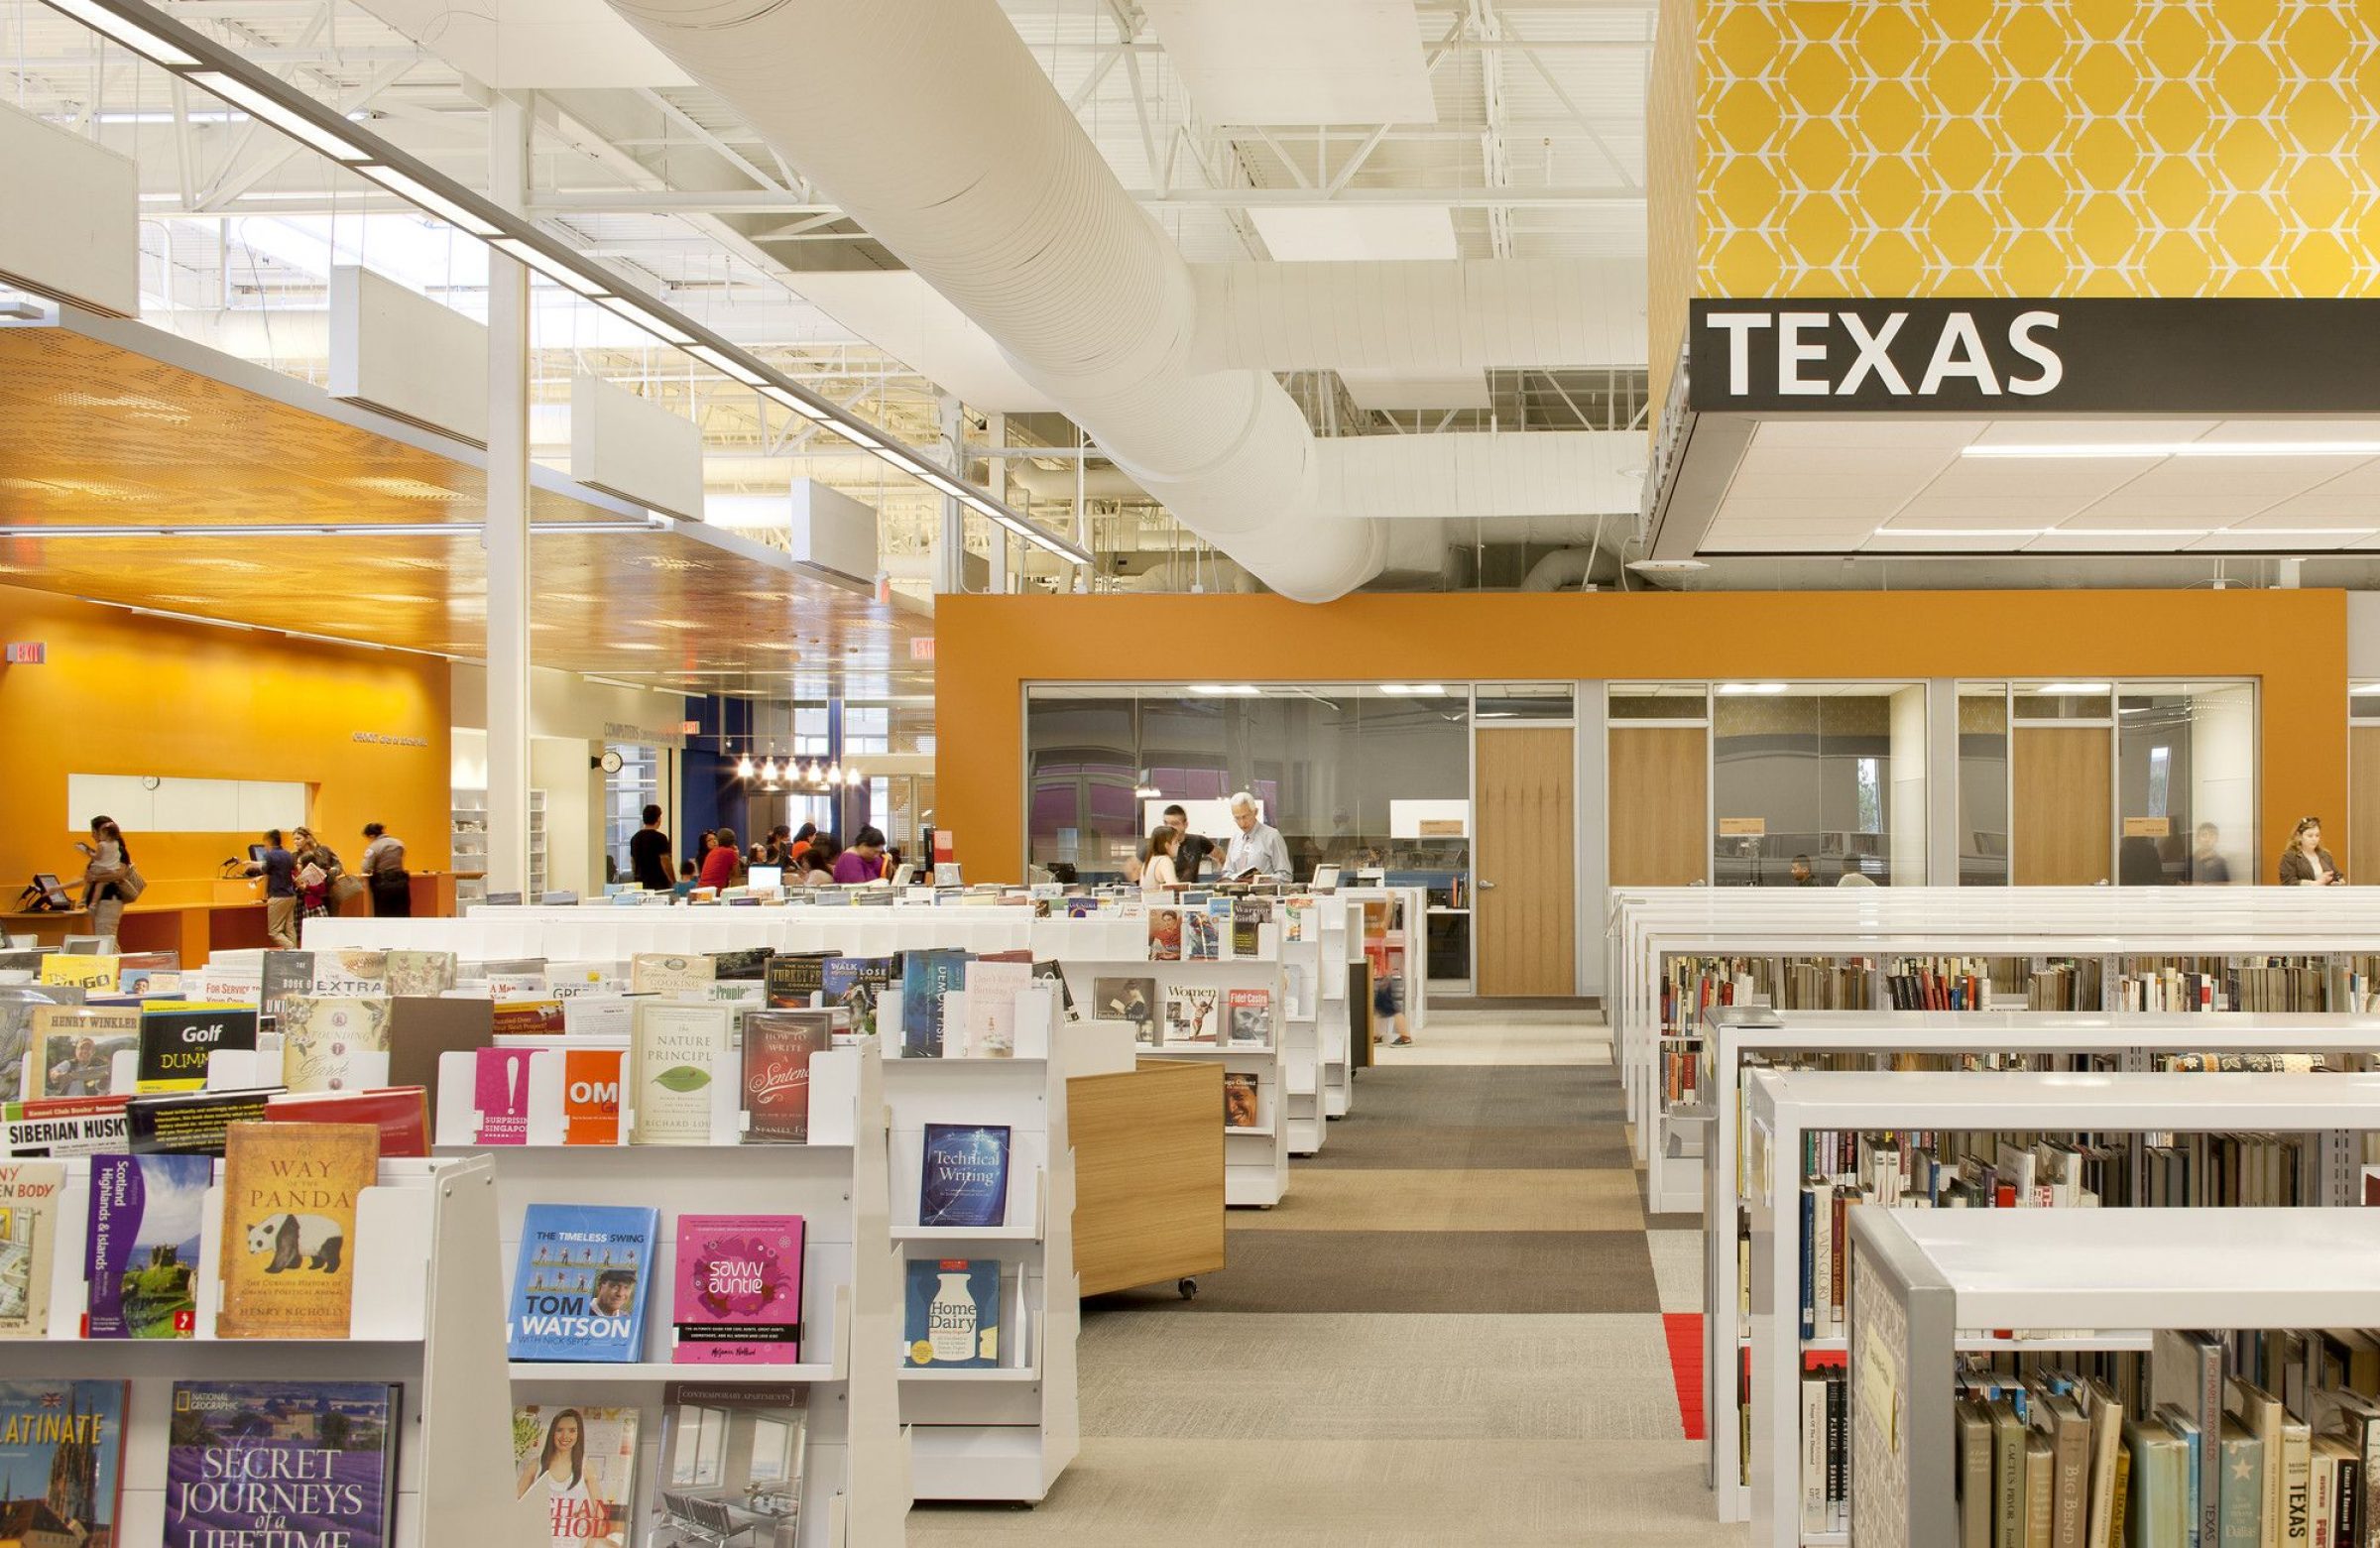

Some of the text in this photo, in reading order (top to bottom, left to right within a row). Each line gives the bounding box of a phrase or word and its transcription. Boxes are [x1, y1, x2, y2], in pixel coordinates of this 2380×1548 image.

[1707, 310, 2064, 396] TEXAS
[17, 644, 42, 661] EXIT
[316, 981, 382, 992] EXTRA
[1168, 986, 1217, 997] Women
[1230, 993, 1267, 1004] Fidel Castro
[52, 1015, 137, 1029] HENRY WINKLER
[181, 1024, 224, 1043] Golf
[657, 1035, 711, 1046] NATURE
[768, 1043, 802, 1052] WRITE
[9, 1121, 78, 1144] SIBERIAN
[933, 1149, 1000, 1166] Technical
[270, 1159, 337, 1178] WAY
[939, 1167, 994, 1187] Writing
[17, 1184, 55, 1198] BODY
[114, 1160, 129, 1207] Scotland
[98, 1167, 114, 1221] Highlands
[250, 1190, 351, 1209] PANDA
[97, 1223, 110, 1232] &
[536, 1232, 645, 1244] THE TIMELESS SWING
[1819, 1229, 1830, 1258] VAIN
[95, 1235, 109, 1270] Islands
[708, 1277, 763, 1293] auntie
[1819, 1261, 1829, 1301] GLORY
[239, 1307, 280, 1317] HENRY
[526, 1295, 584, 1316] TOM
[930, 1301, 977, 1316] Home
[522, 1315, 632, 1339] WATSON
[929, 1315, 976, 1334] Dairy
[190, 1391, 229, 1402] NATIONAL
[682, 1390, 790, 1401] CONTEMPORARY APARTMENTS
[190, 1400, 239, 1411] GEOGRAPHIC
[0, 1412, 104, 1445] ATINATE
[2205, 1357, 2216, 1542] RICHARD REYNOLDS TEXAS
[201, 1448, 342, 1481] SECRET
[2006, 1443, 2017, 1520] CACTUS PRYOR
[178, 1483, 363, 1524] JOURNEYS
[2063, 1464, 2080, 1545] BIG BEND
[2289, 1482, 2307, 1538] TEXAS
[255, 1506, 287, 1537] of a
[2225, 1524, 2256, 1537] Dallas
